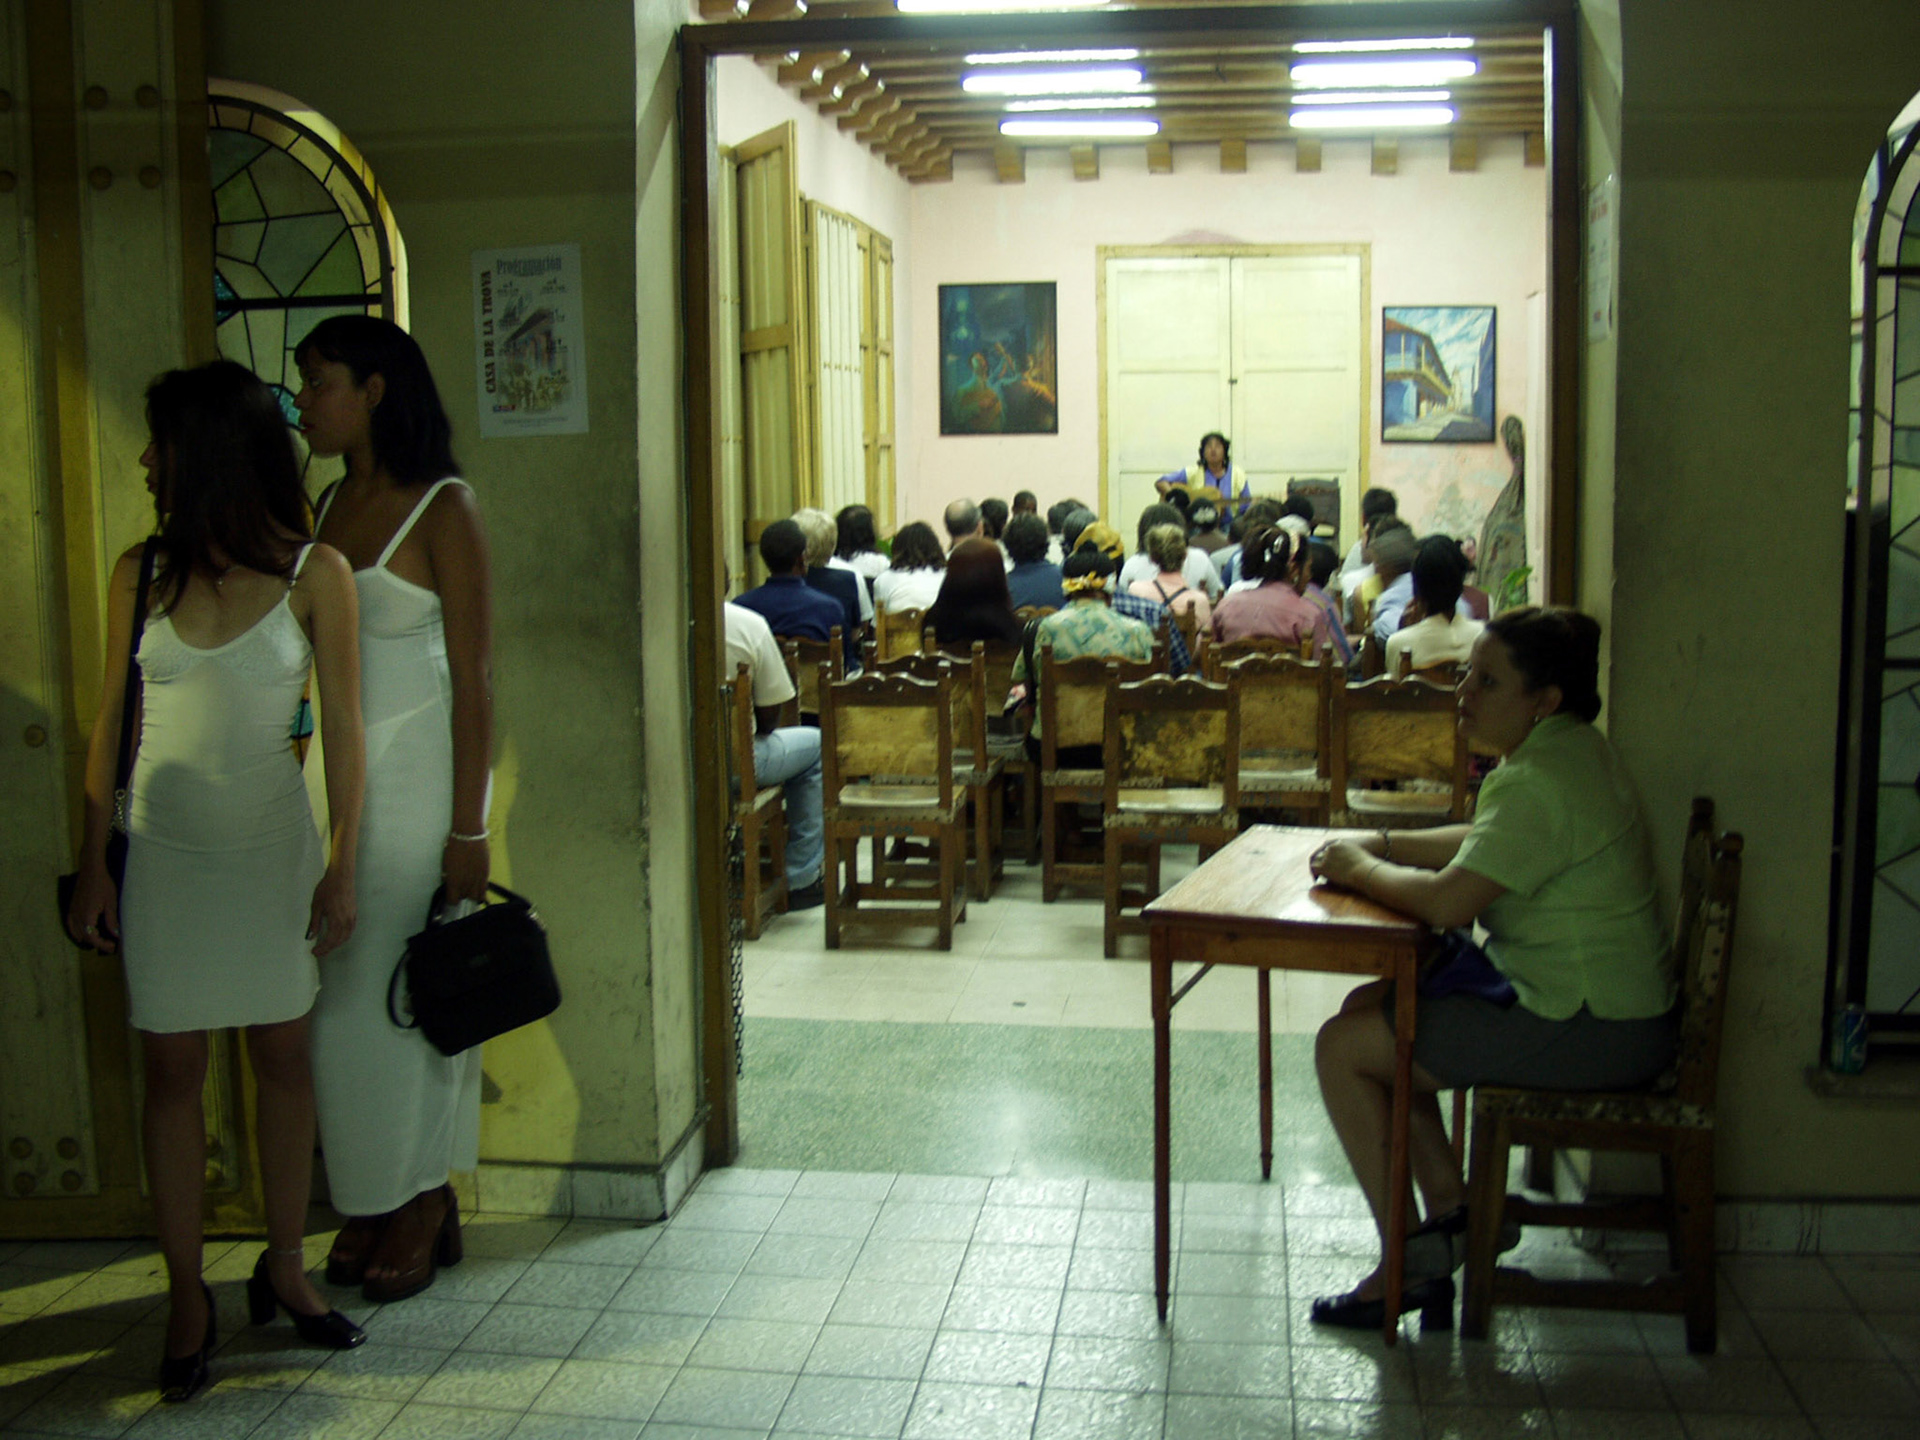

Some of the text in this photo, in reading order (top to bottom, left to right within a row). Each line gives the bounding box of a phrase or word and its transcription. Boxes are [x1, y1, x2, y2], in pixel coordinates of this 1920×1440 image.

[481, 270, 496, 393] CASA DE LA TROVA
